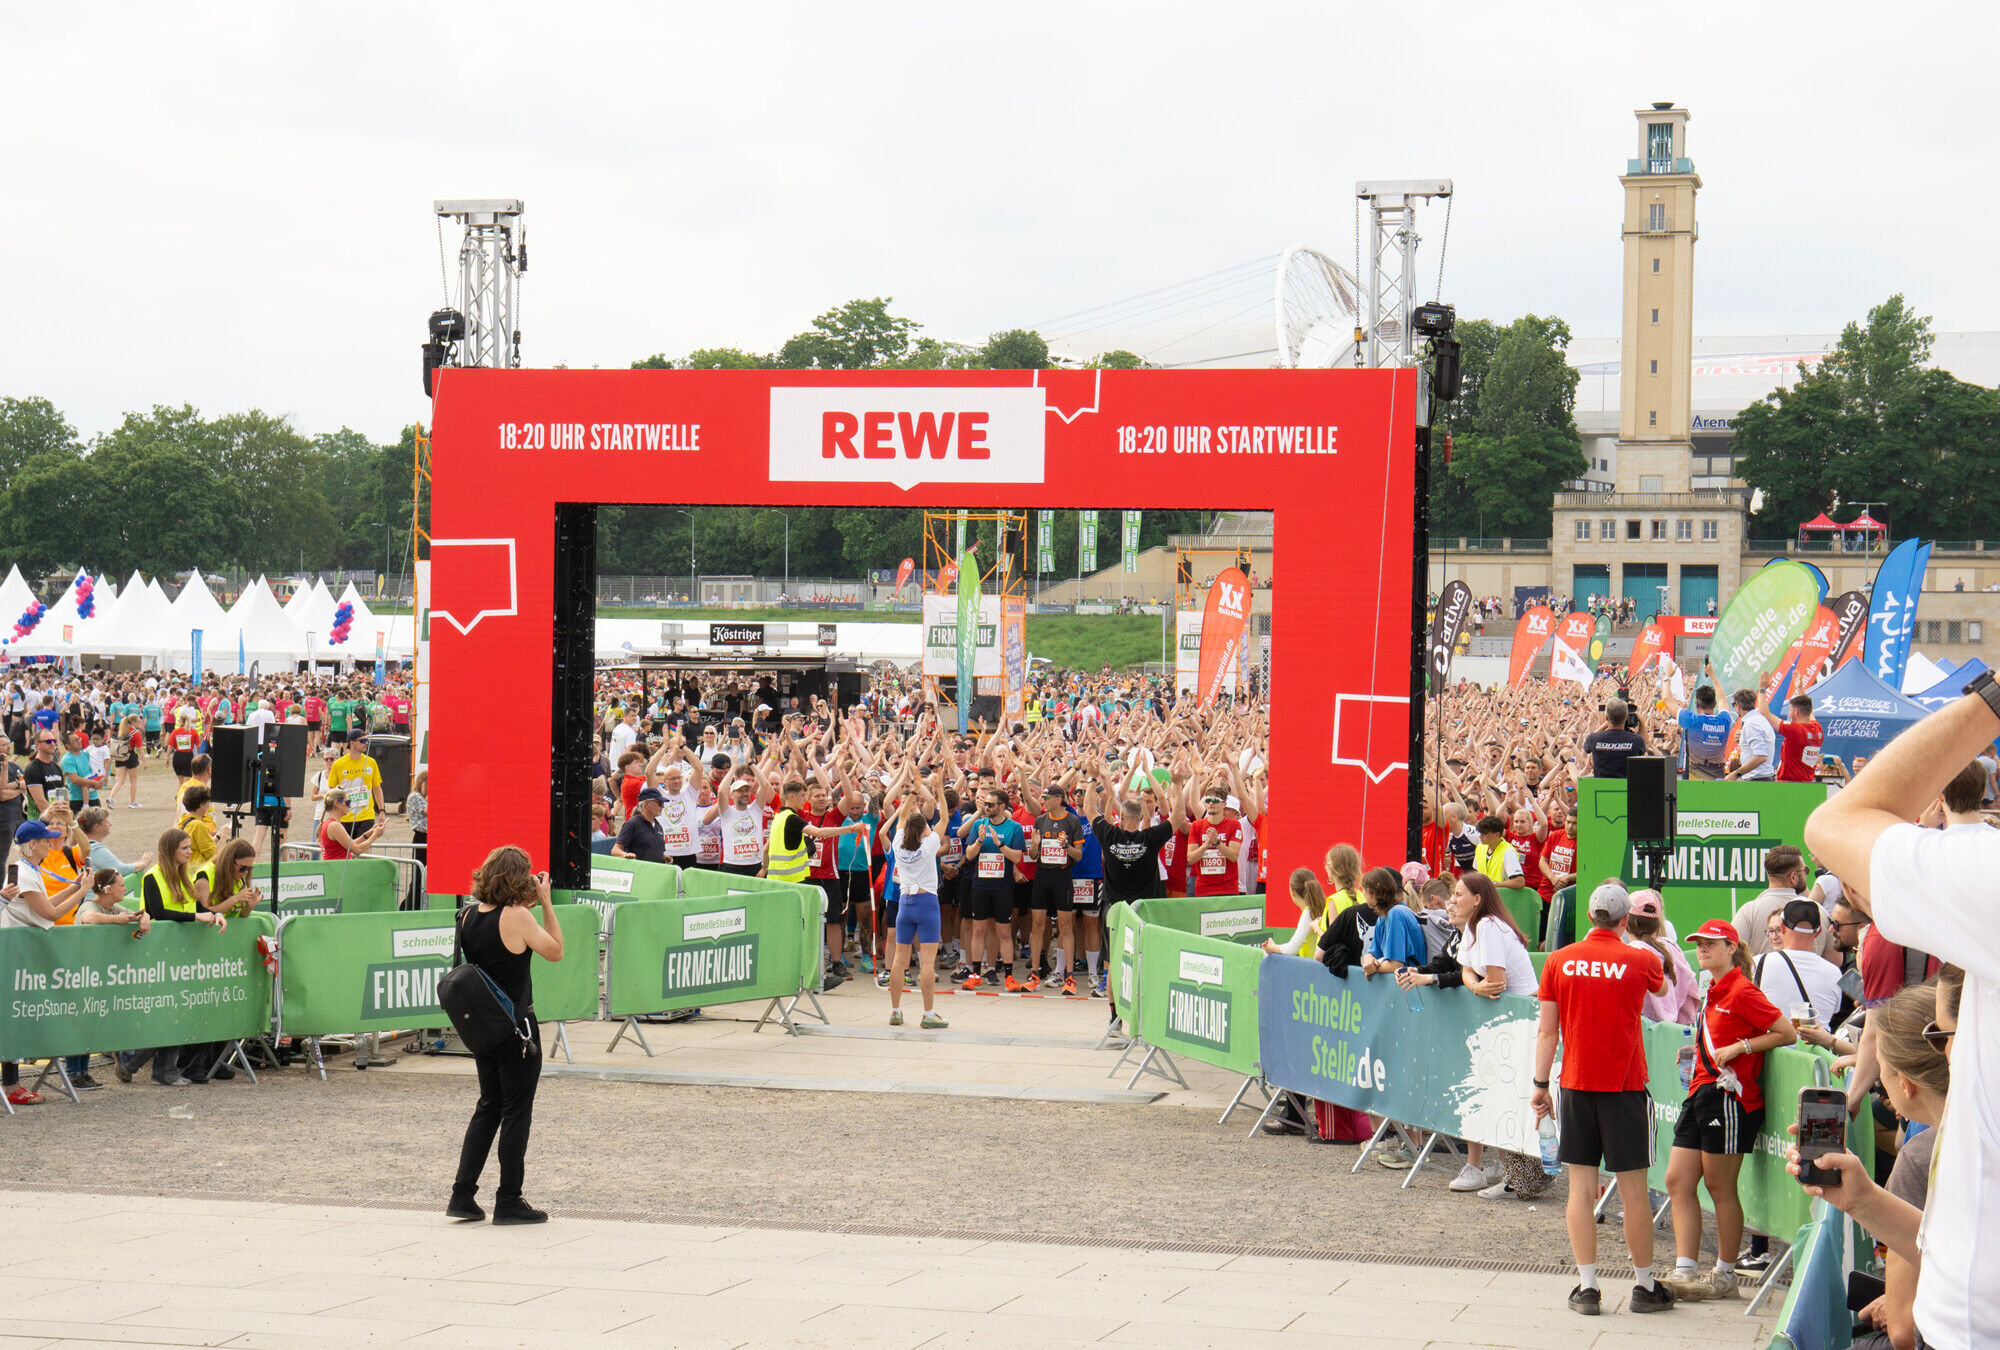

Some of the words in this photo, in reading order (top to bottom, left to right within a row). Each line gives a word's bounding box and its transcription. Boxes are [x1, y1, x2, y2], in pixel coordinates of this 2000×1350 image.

[498, 423, 545, 450] 18:20
[550, 423, 584, 450] UHR
[590, 423, 700, 451] STARTWELLE
[822, 411, 990, 460] REWE
[1117, 425, 1168, 454] 18:20
[1173, 425, 1211, 454] UHR
[1216, 425, 1338, 454] STARTWELLE
[1443, 588, 1465, 643] artiva
[713, 626, 761, 643] Köstritzer
[1723, 607, 1777, 678] schnelle
[1746, 602, 1808, 673] Stelle.de
[1827, 719, 1880, 730] LEIPZIGER
[1827, 729, 1879, 738] LAUFLADEN
[1678, 818, 1750, 829] nelleStelle.de
[982, 861, 1000, 870] 11787
[1203, 858, 1222, 867] 11690
[1632, 845, 1771, 882] FIMENLAUF
[688, 916, 742, 932] schnelleStelle.de
[1206, 915, 1259, 929] schnelleStelle.de
[402, 935, 454, 948] schnelleS
[14, 968, 47, 991] Ihre
[51, 966, 103, 990] Stelle.
[106, 961, 165, 986] Schnell
[170, 957, 248, 982] verbreitet.
[668, 944, 752, 989] FIRMENLAUF
[1562, 960, 1627, 980] CREW
[12, 1000, 79, 1021] StepStone,
[82, 997, 109, 1017] Xing,
[113, 993, 178, 1014] Instagram,
[181, 989, 221, 1009] Spotify
[222, 987, 231, 1002] &
[233, 985, 247, 1001] Co.
[1170, 989, 1228, 1044] FIRMENLAUF
[1292, 983, 1362, 1034] schnelle
[1311, 1034, 1386, 1092] Stelle.de
